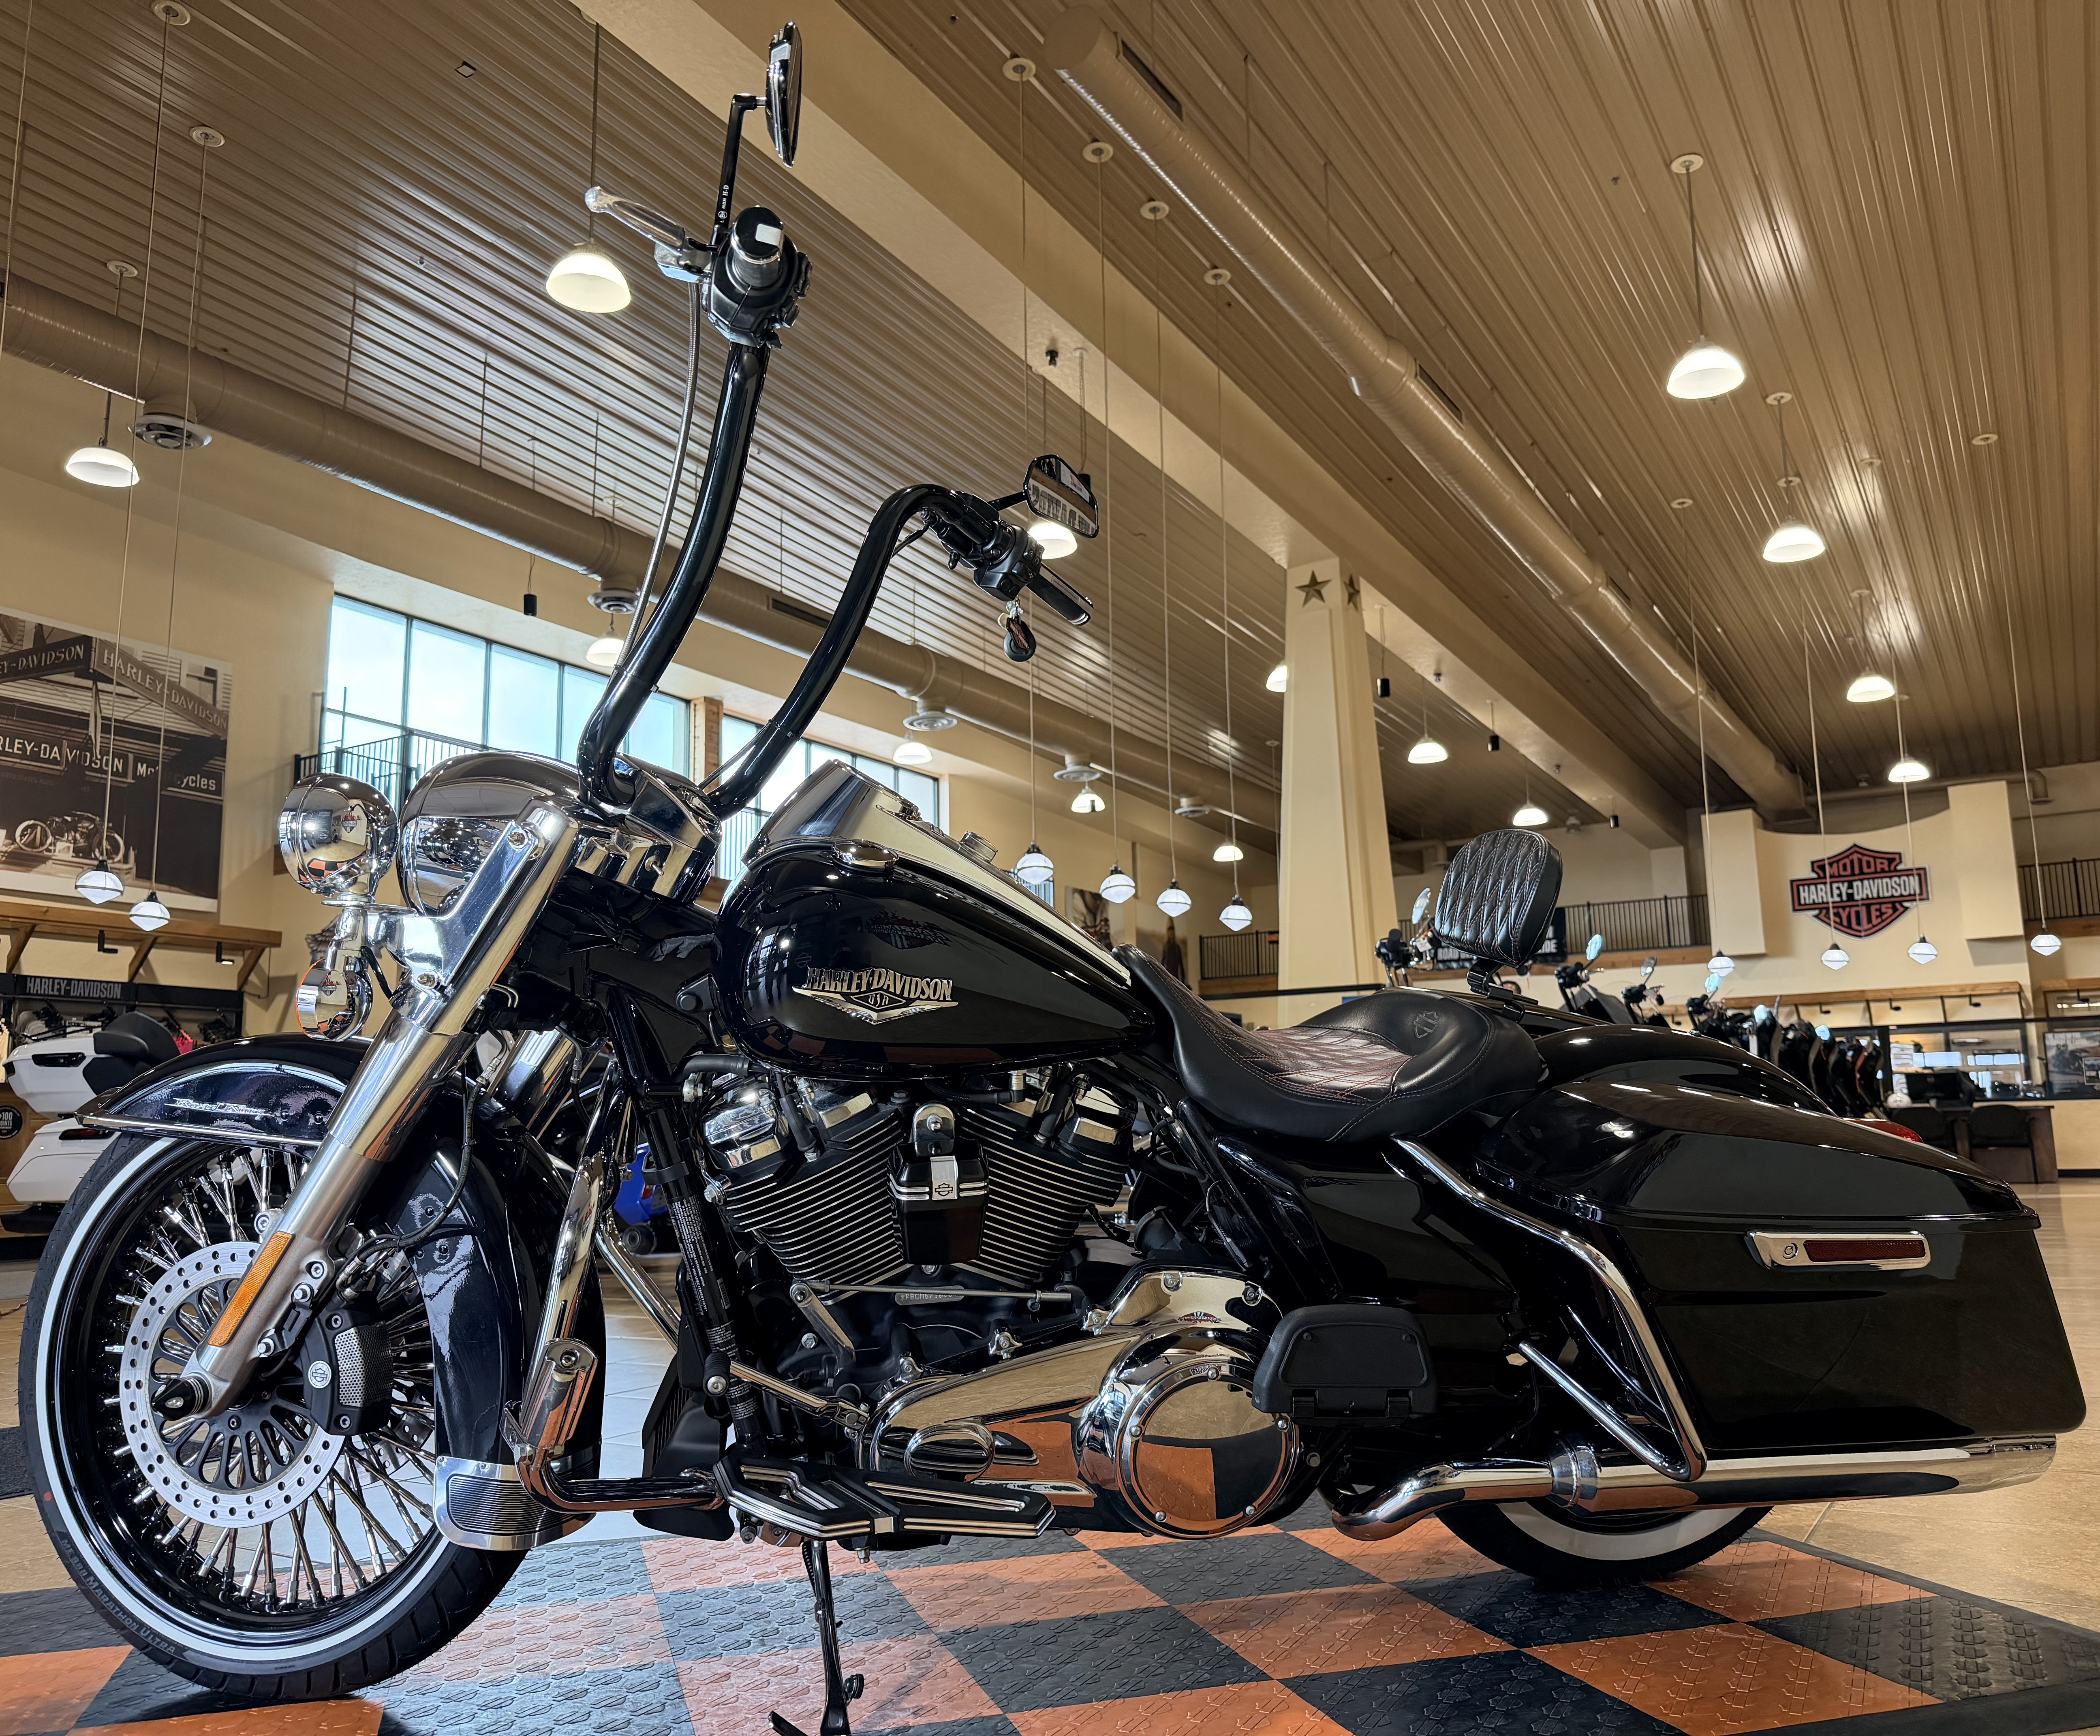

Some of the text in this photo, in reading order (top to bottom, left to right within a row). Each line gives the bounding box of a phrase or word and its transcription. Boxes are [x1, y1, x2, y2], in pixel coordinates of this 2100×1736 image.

[103, 649, 228, 729] HARLEY-DAVIDSON
[1827, 854, 1889, 876] MOTOR
[1799, 874, 1920, 905] HARLEY-DAVIDSON
[1831, 903, 1893, 931] CYCLES
[26, 977, 122, 999] HARLEY-DAVIDSON
[803, 967, 953, 1001] HARLEY-DAVIDSON
[868, 993, 889, 1007] USA
[86, 1576, 139, 1631] MARATHON
[141, 1626, 175, 1655] ULTRA
